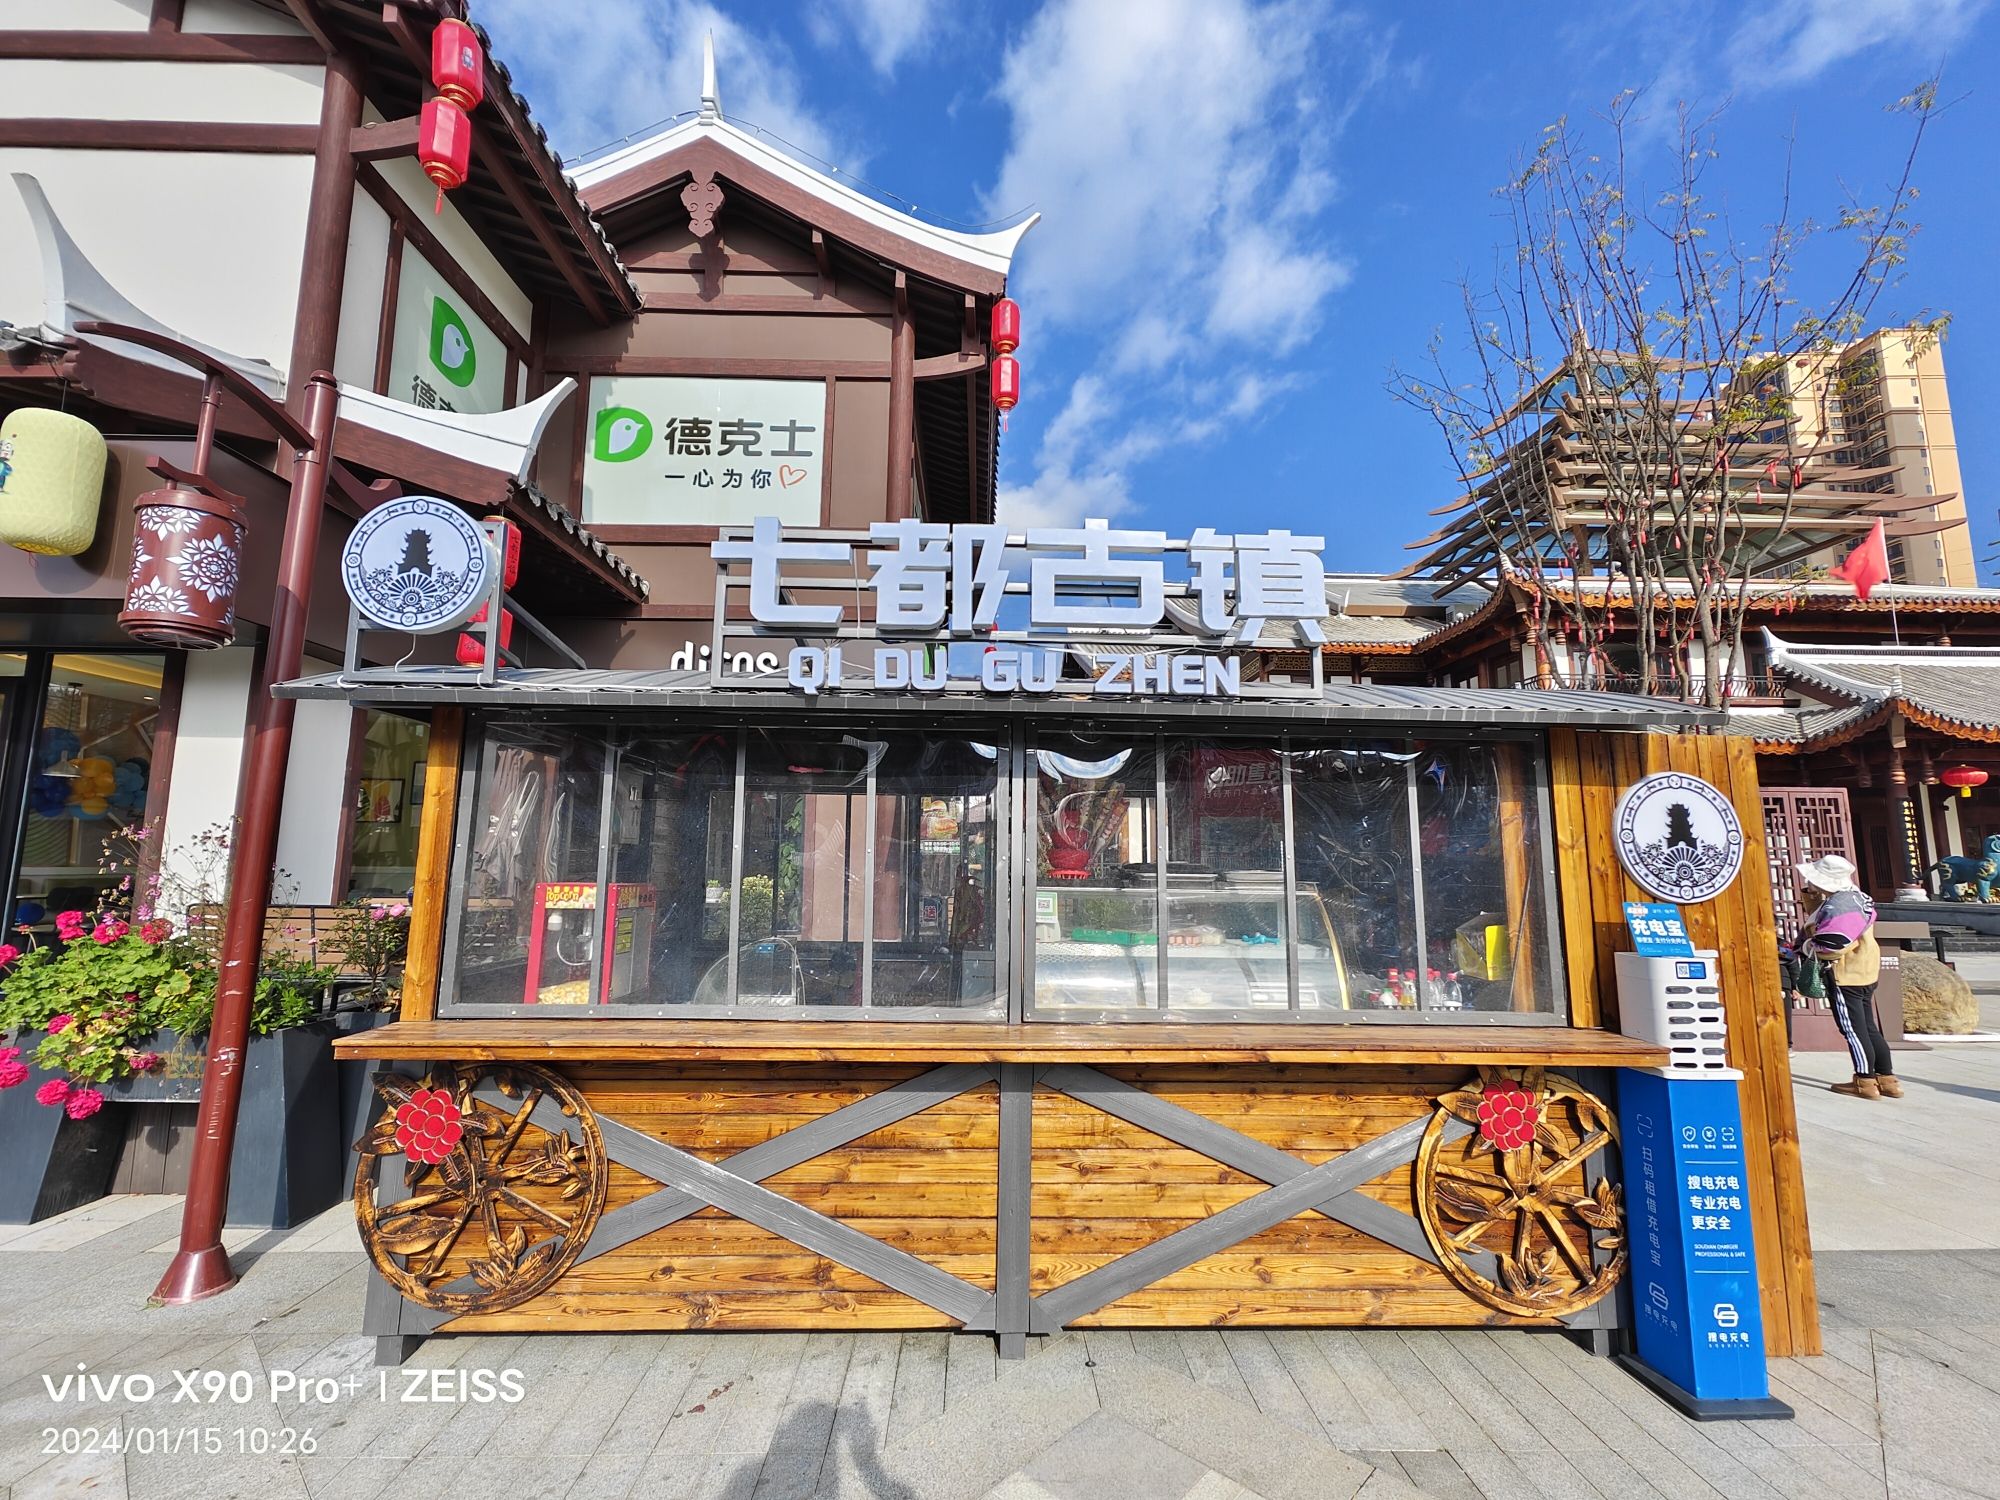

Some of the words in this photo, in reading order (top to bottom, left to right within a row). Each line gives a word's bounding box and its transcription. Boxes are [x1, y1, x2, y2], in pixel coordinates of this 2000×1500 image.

[664, 417, 816, 457] 德克士
[664, 468, 772, 489] 一心为你
[711, 516, 1330, 646] 七都古镇
[670, 640, 779, 673] dios
[787, 646, 843, 696] QI
[874, 647, 949, 691] DU
[981, 650, 1057, 693] GU
[1094, 652, 1241, 696] ZHEN
[1630, 918, 1685, 936] 充电宝
[1687, 1175, 1739, 1190] 搜电充电
[1689, 1195, 1741, 1210] 专业充电
[1691, 1215, 1731, 1230] 更安全
